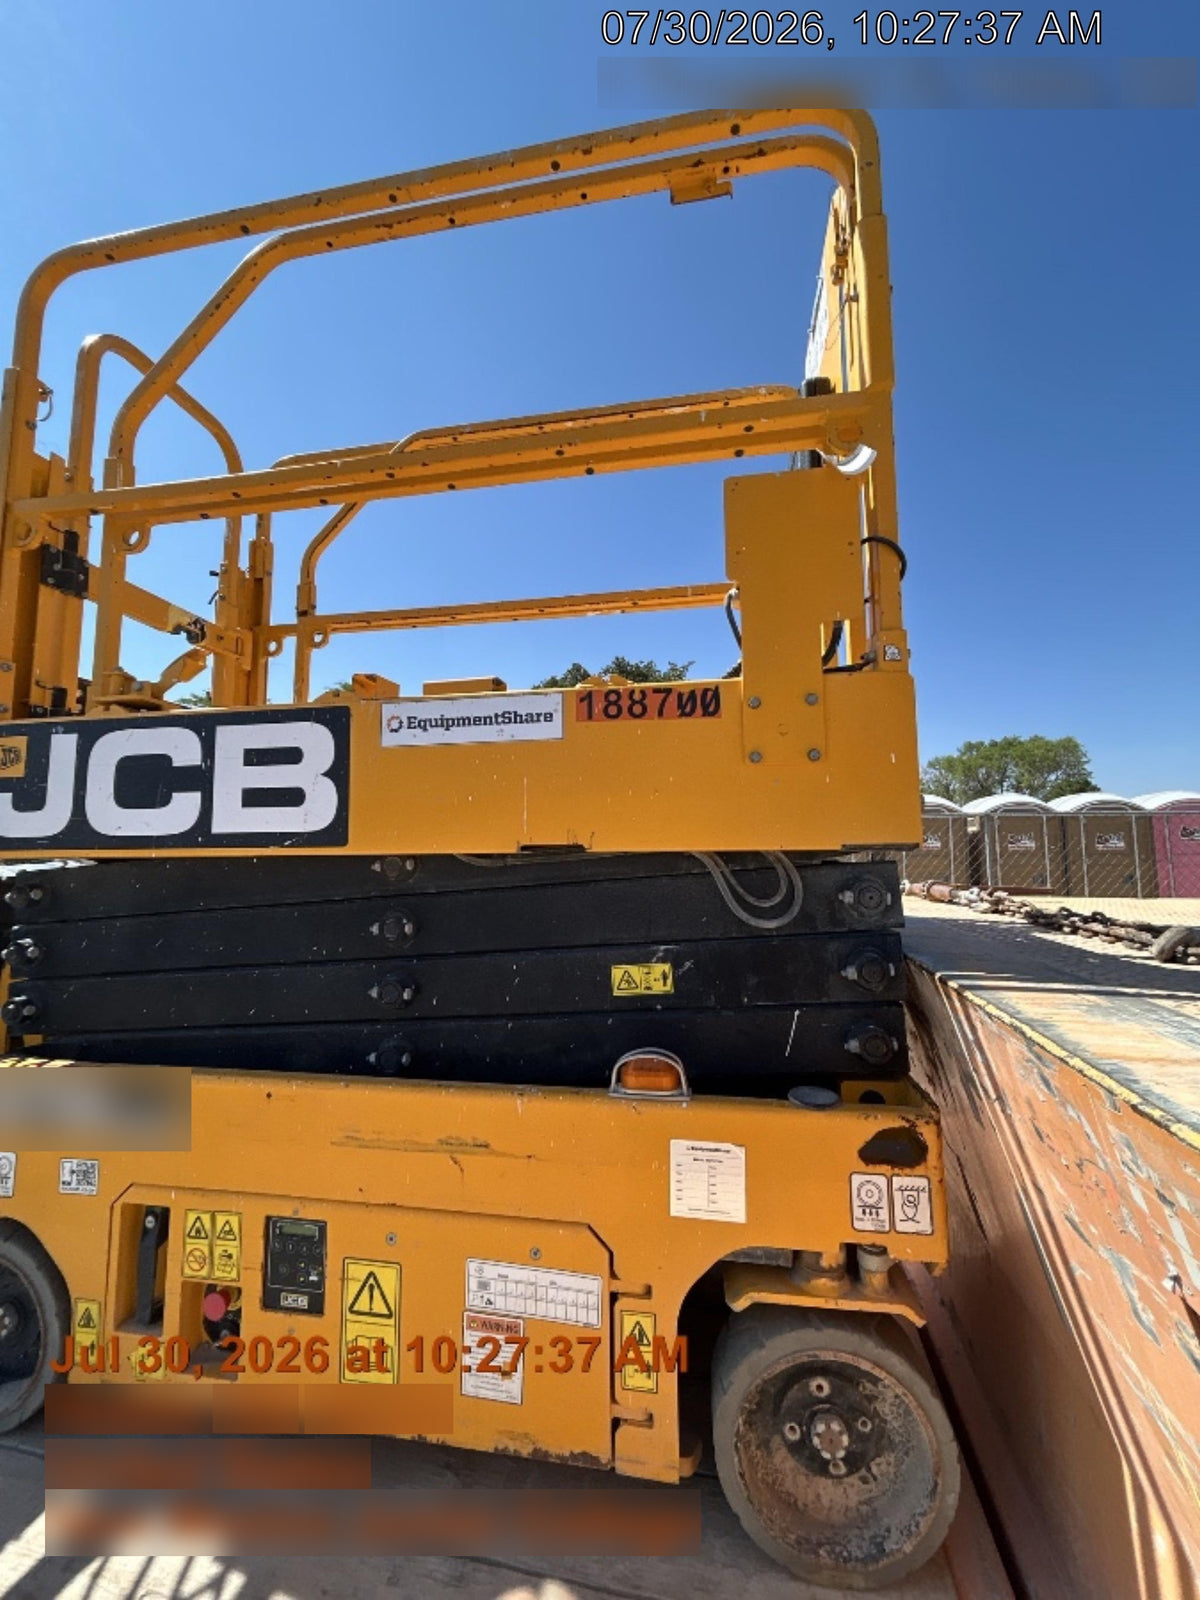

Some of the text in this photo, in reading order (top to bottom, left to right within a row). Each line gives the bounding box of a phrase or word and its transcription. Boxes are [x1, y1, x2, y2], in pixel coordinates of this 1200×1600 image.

[579, 685, 720, 720] 188700
[406, 710, 554, 732] EquipmentShare
[0, 721, 339, 838] JCB
